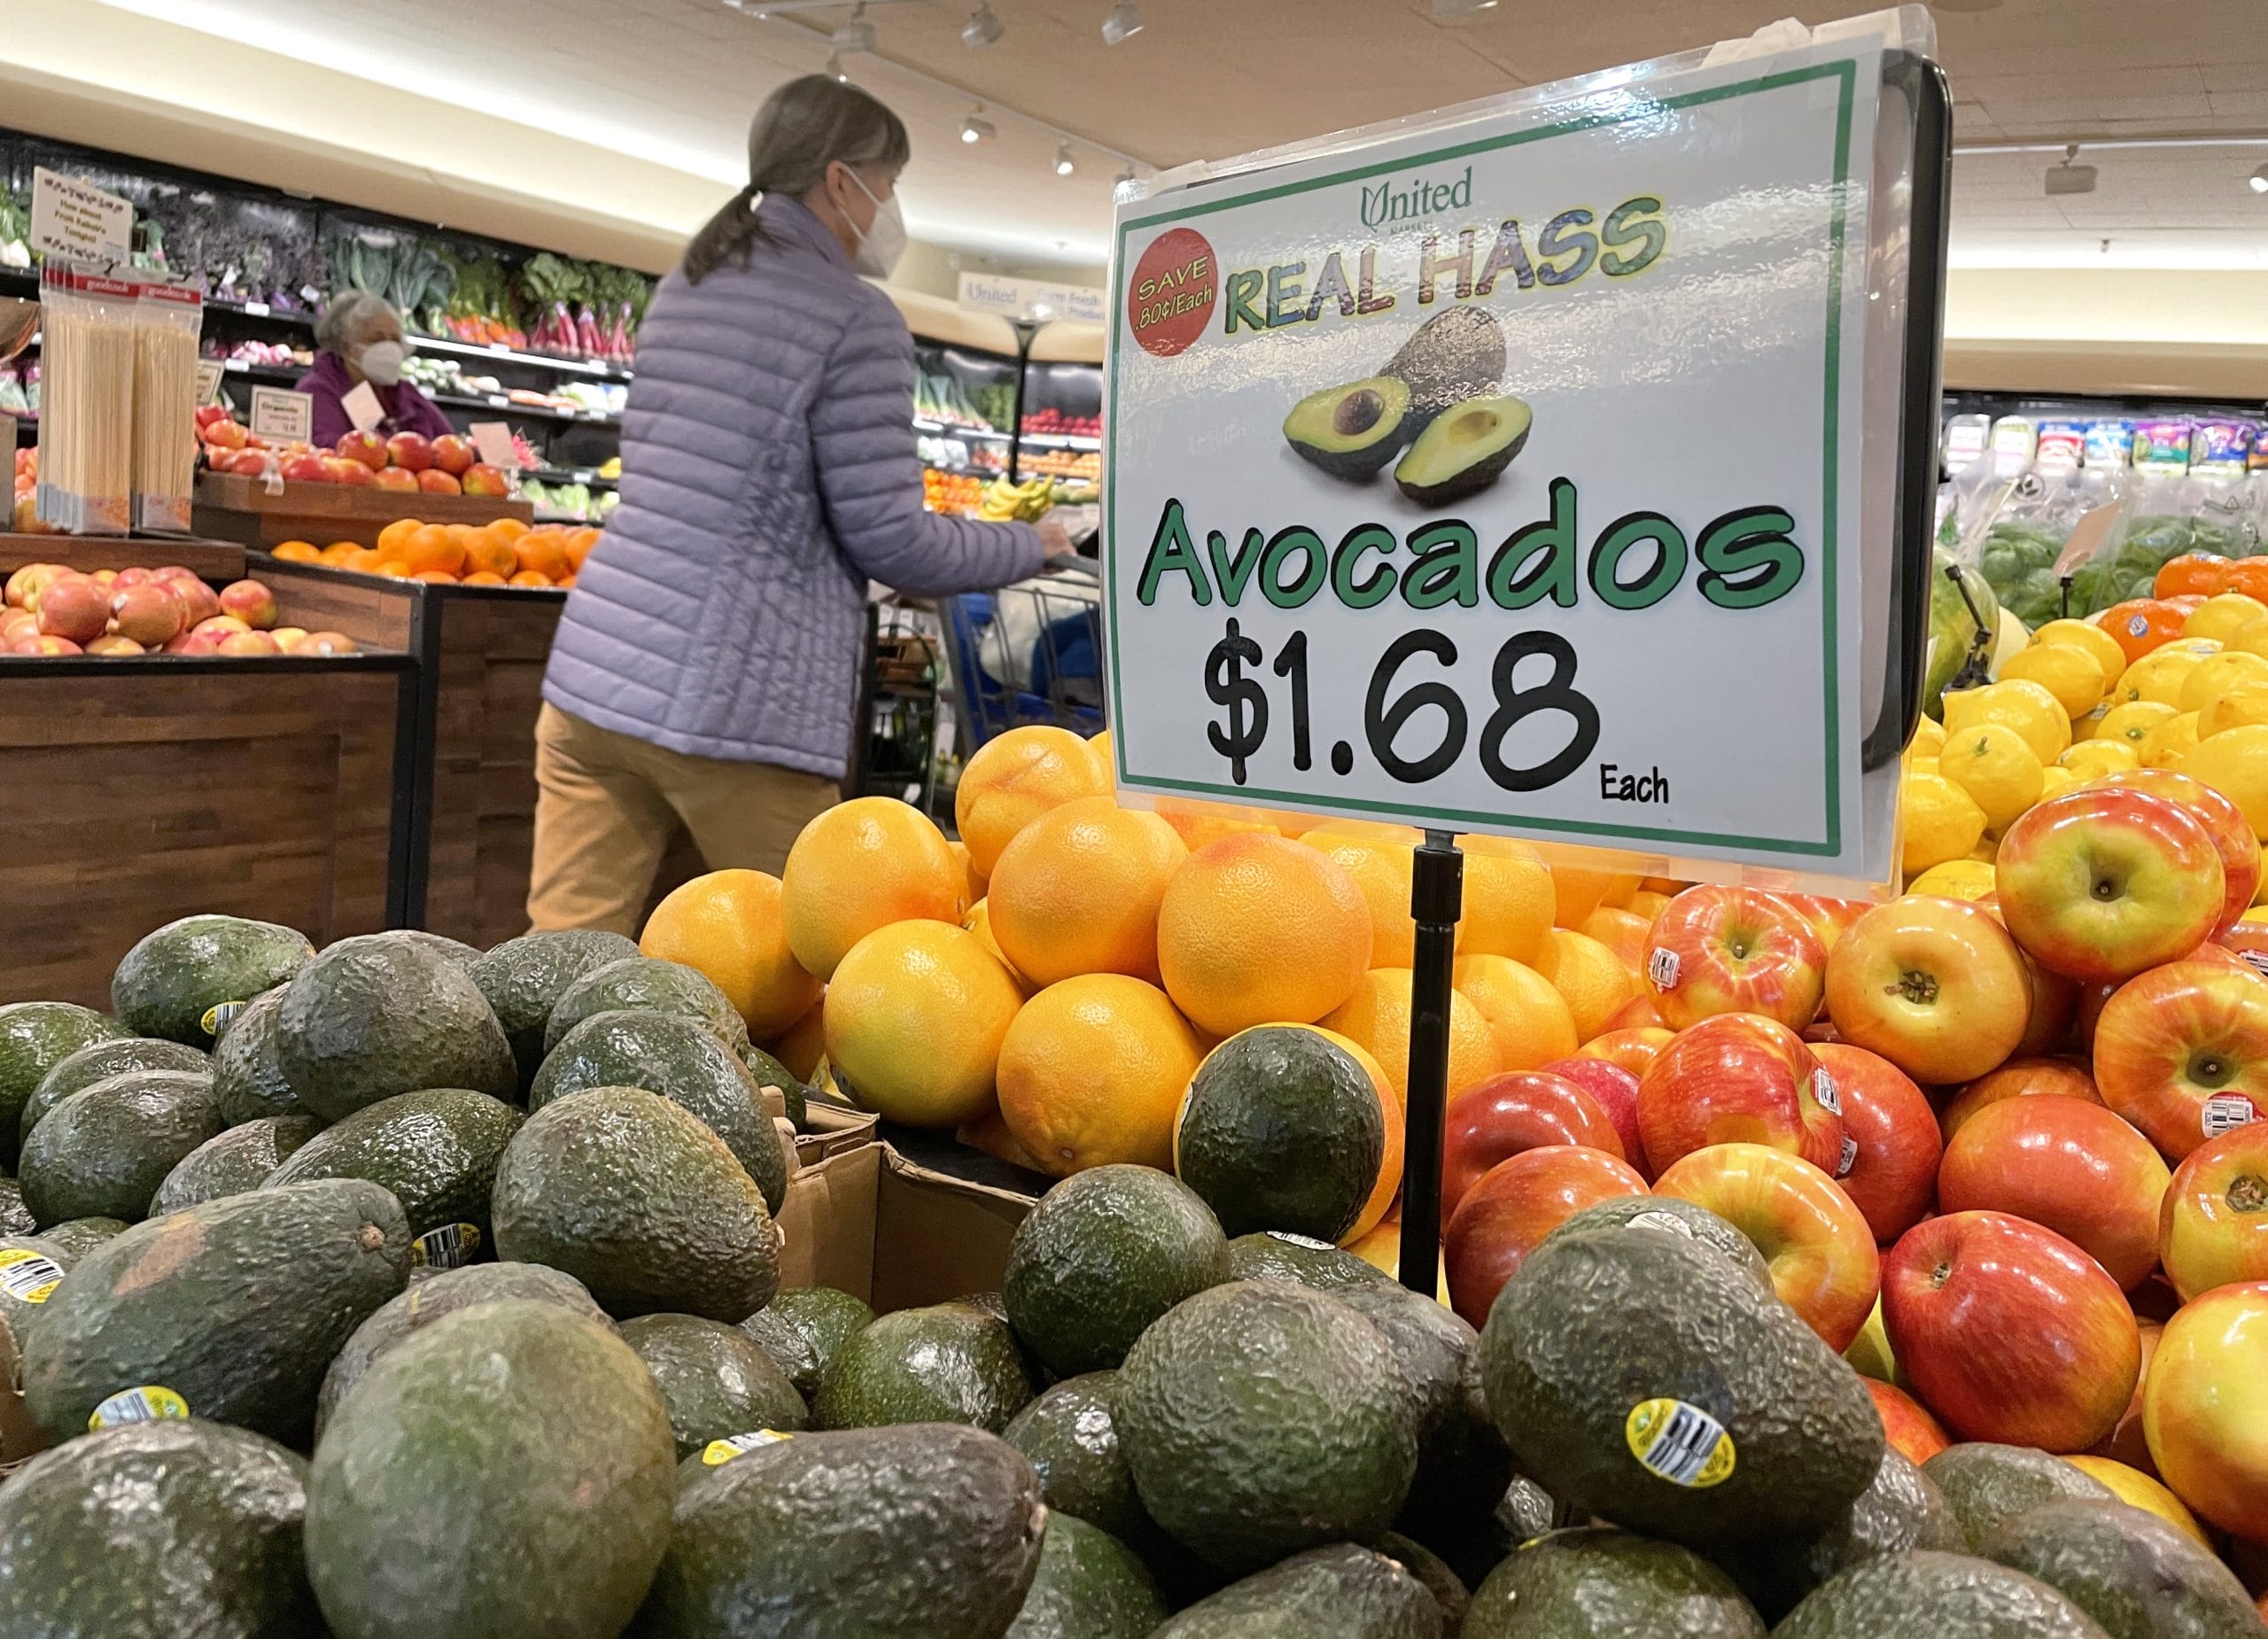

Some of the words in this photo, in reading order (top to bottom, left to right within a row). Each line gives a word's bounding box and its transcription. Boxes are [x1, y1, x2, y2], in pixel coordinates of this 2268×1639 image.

[1224, 248, 1395, 334] REAL
[1418, 197, 1666, 304] HASS
[1361, 166, 1472, 233] United
[1138, 256, 1208, 301] SAVE
[1137, 477, 1805, 610] Avocados
[1204, 618, 1601, 792] $1.68
[1600, 764, 1669, 804] Each
